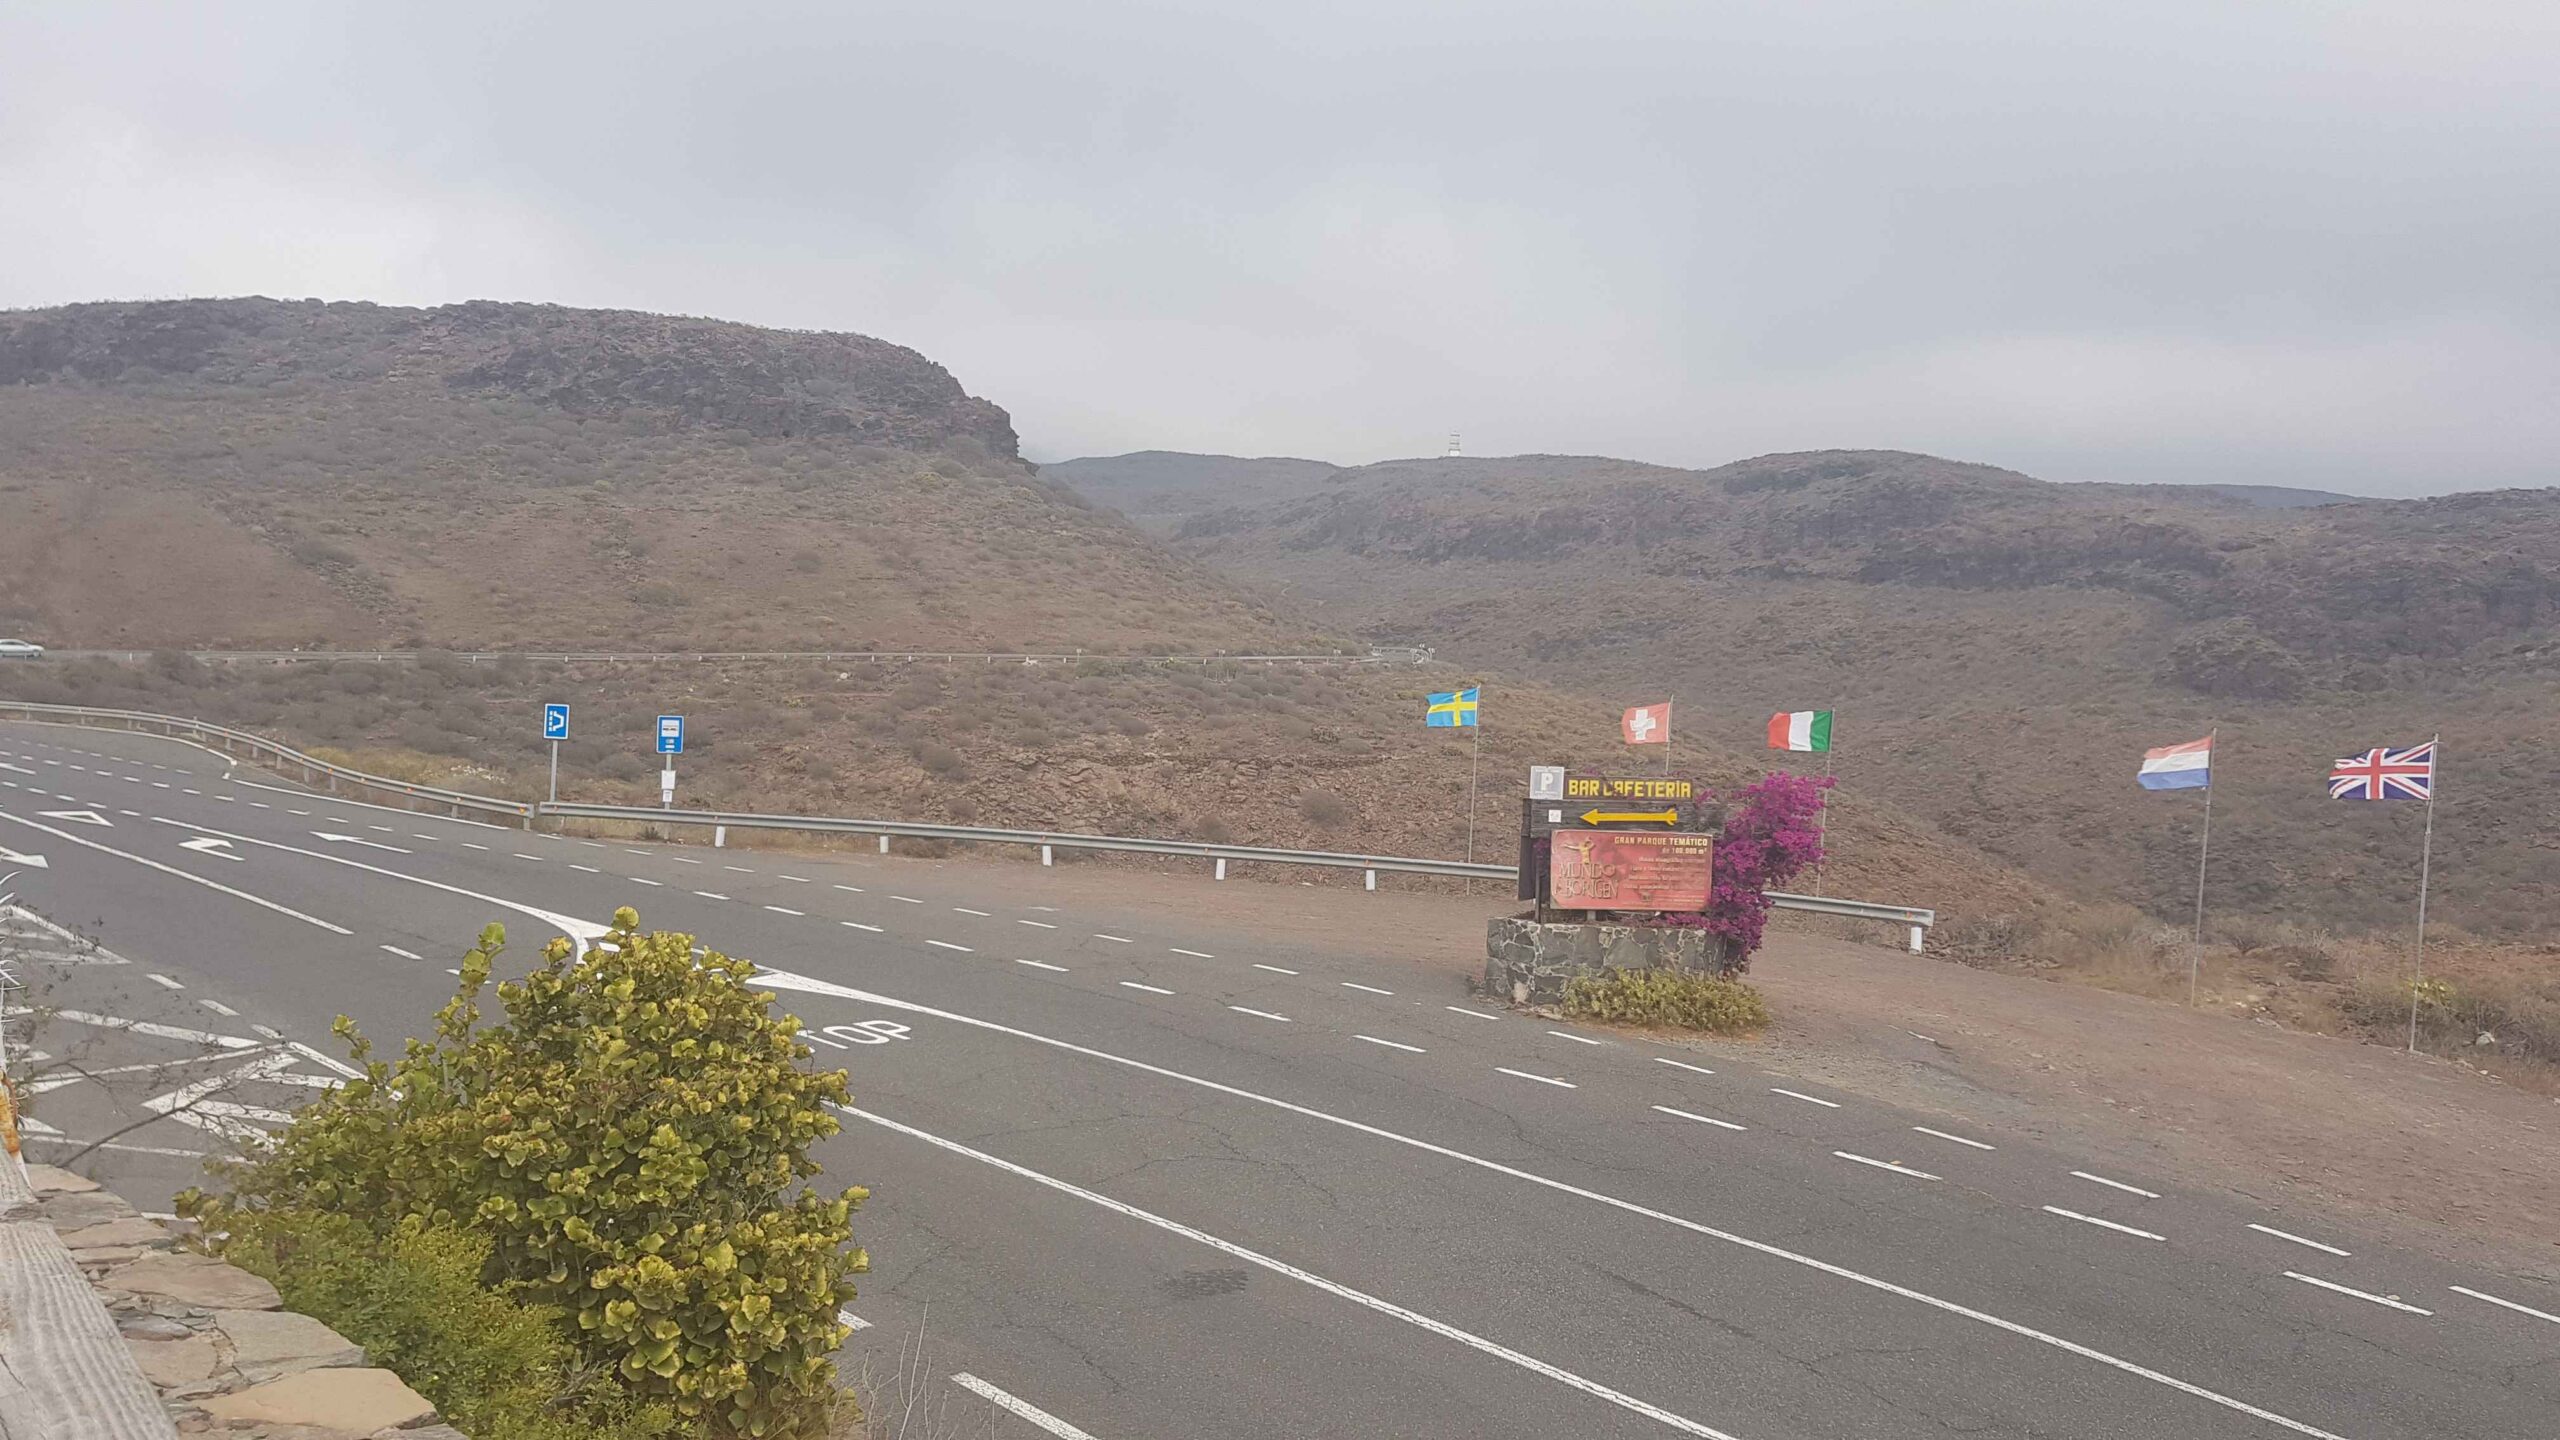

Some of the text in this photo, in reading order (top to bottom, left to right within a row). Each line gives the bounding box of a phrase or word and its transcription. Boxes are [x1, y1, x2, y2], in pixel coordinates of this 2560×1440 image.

[1541, 772, 1554, 791] P
[1568, 779, 1599, 796] BAR
[1614, 835, 1708, 847] GRAN PARQUE TEMÁTICO
[1559, 862, 1616, 880] MUNDO
[1555, 880, 1619, 900] ABORIGEN
